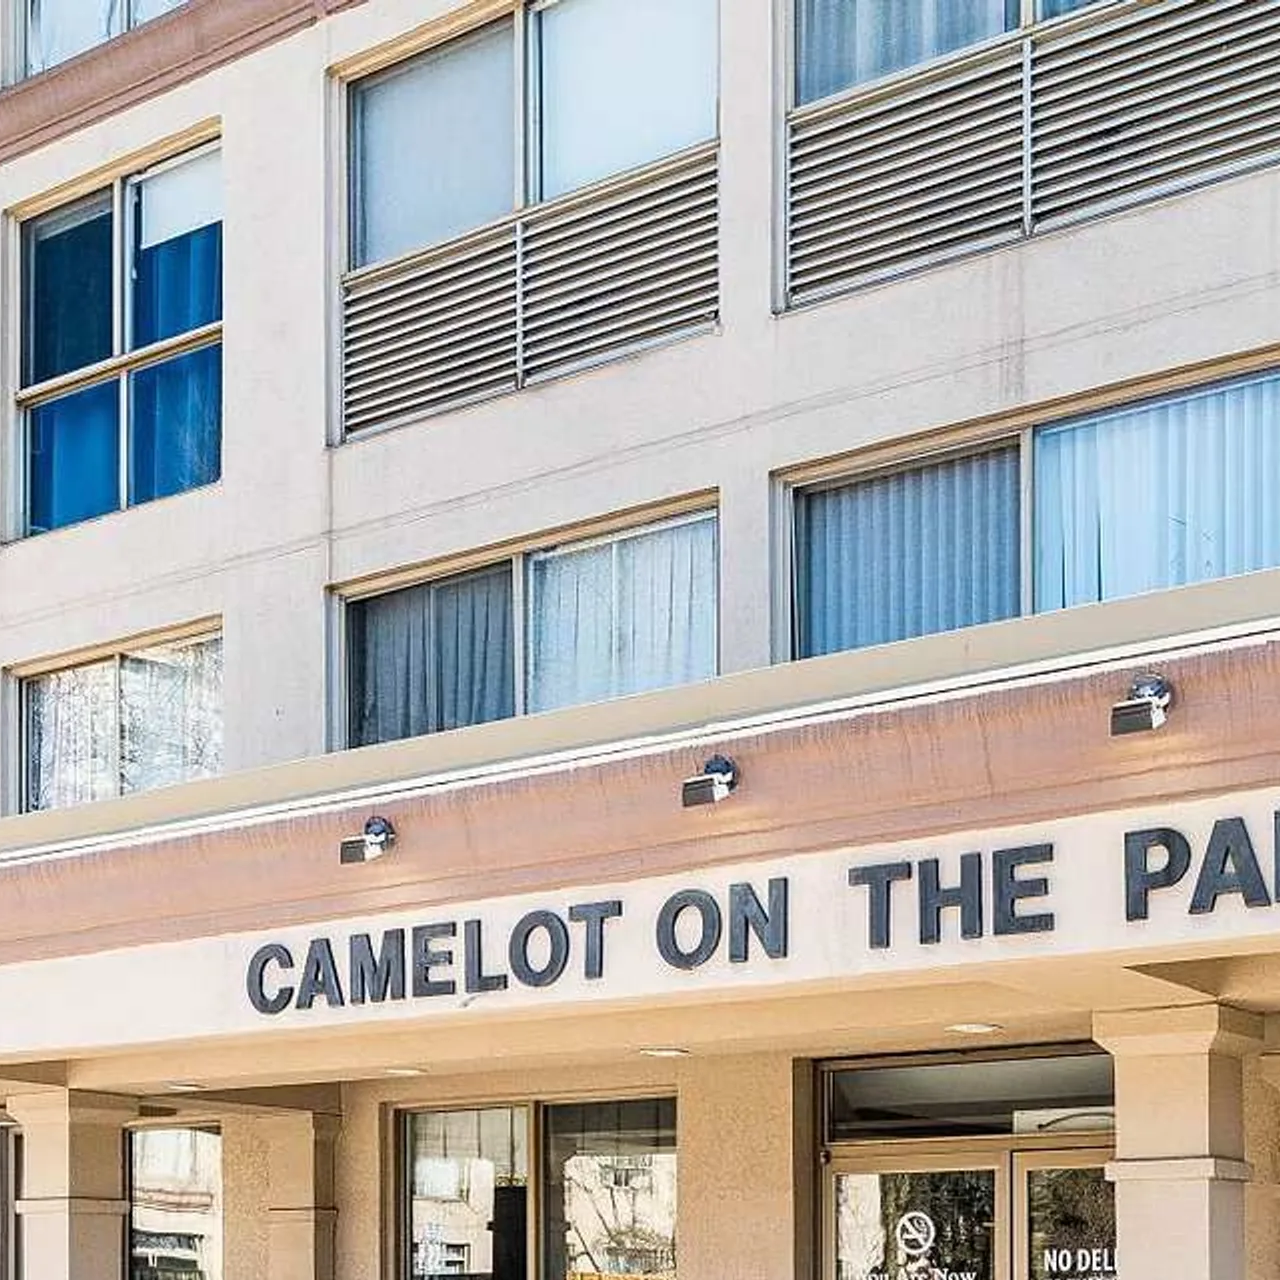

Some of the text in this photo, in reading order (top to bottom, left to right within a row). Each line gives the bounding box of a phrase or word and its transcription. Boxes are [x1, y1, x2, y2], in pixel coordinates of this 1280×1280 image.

[246, 900, 623, 1015] CAMELOT
[656, 876, 789, 970] ON
[848, 843, 1055, 950] THE
[1044, 1248, 1072, 1272] NO
